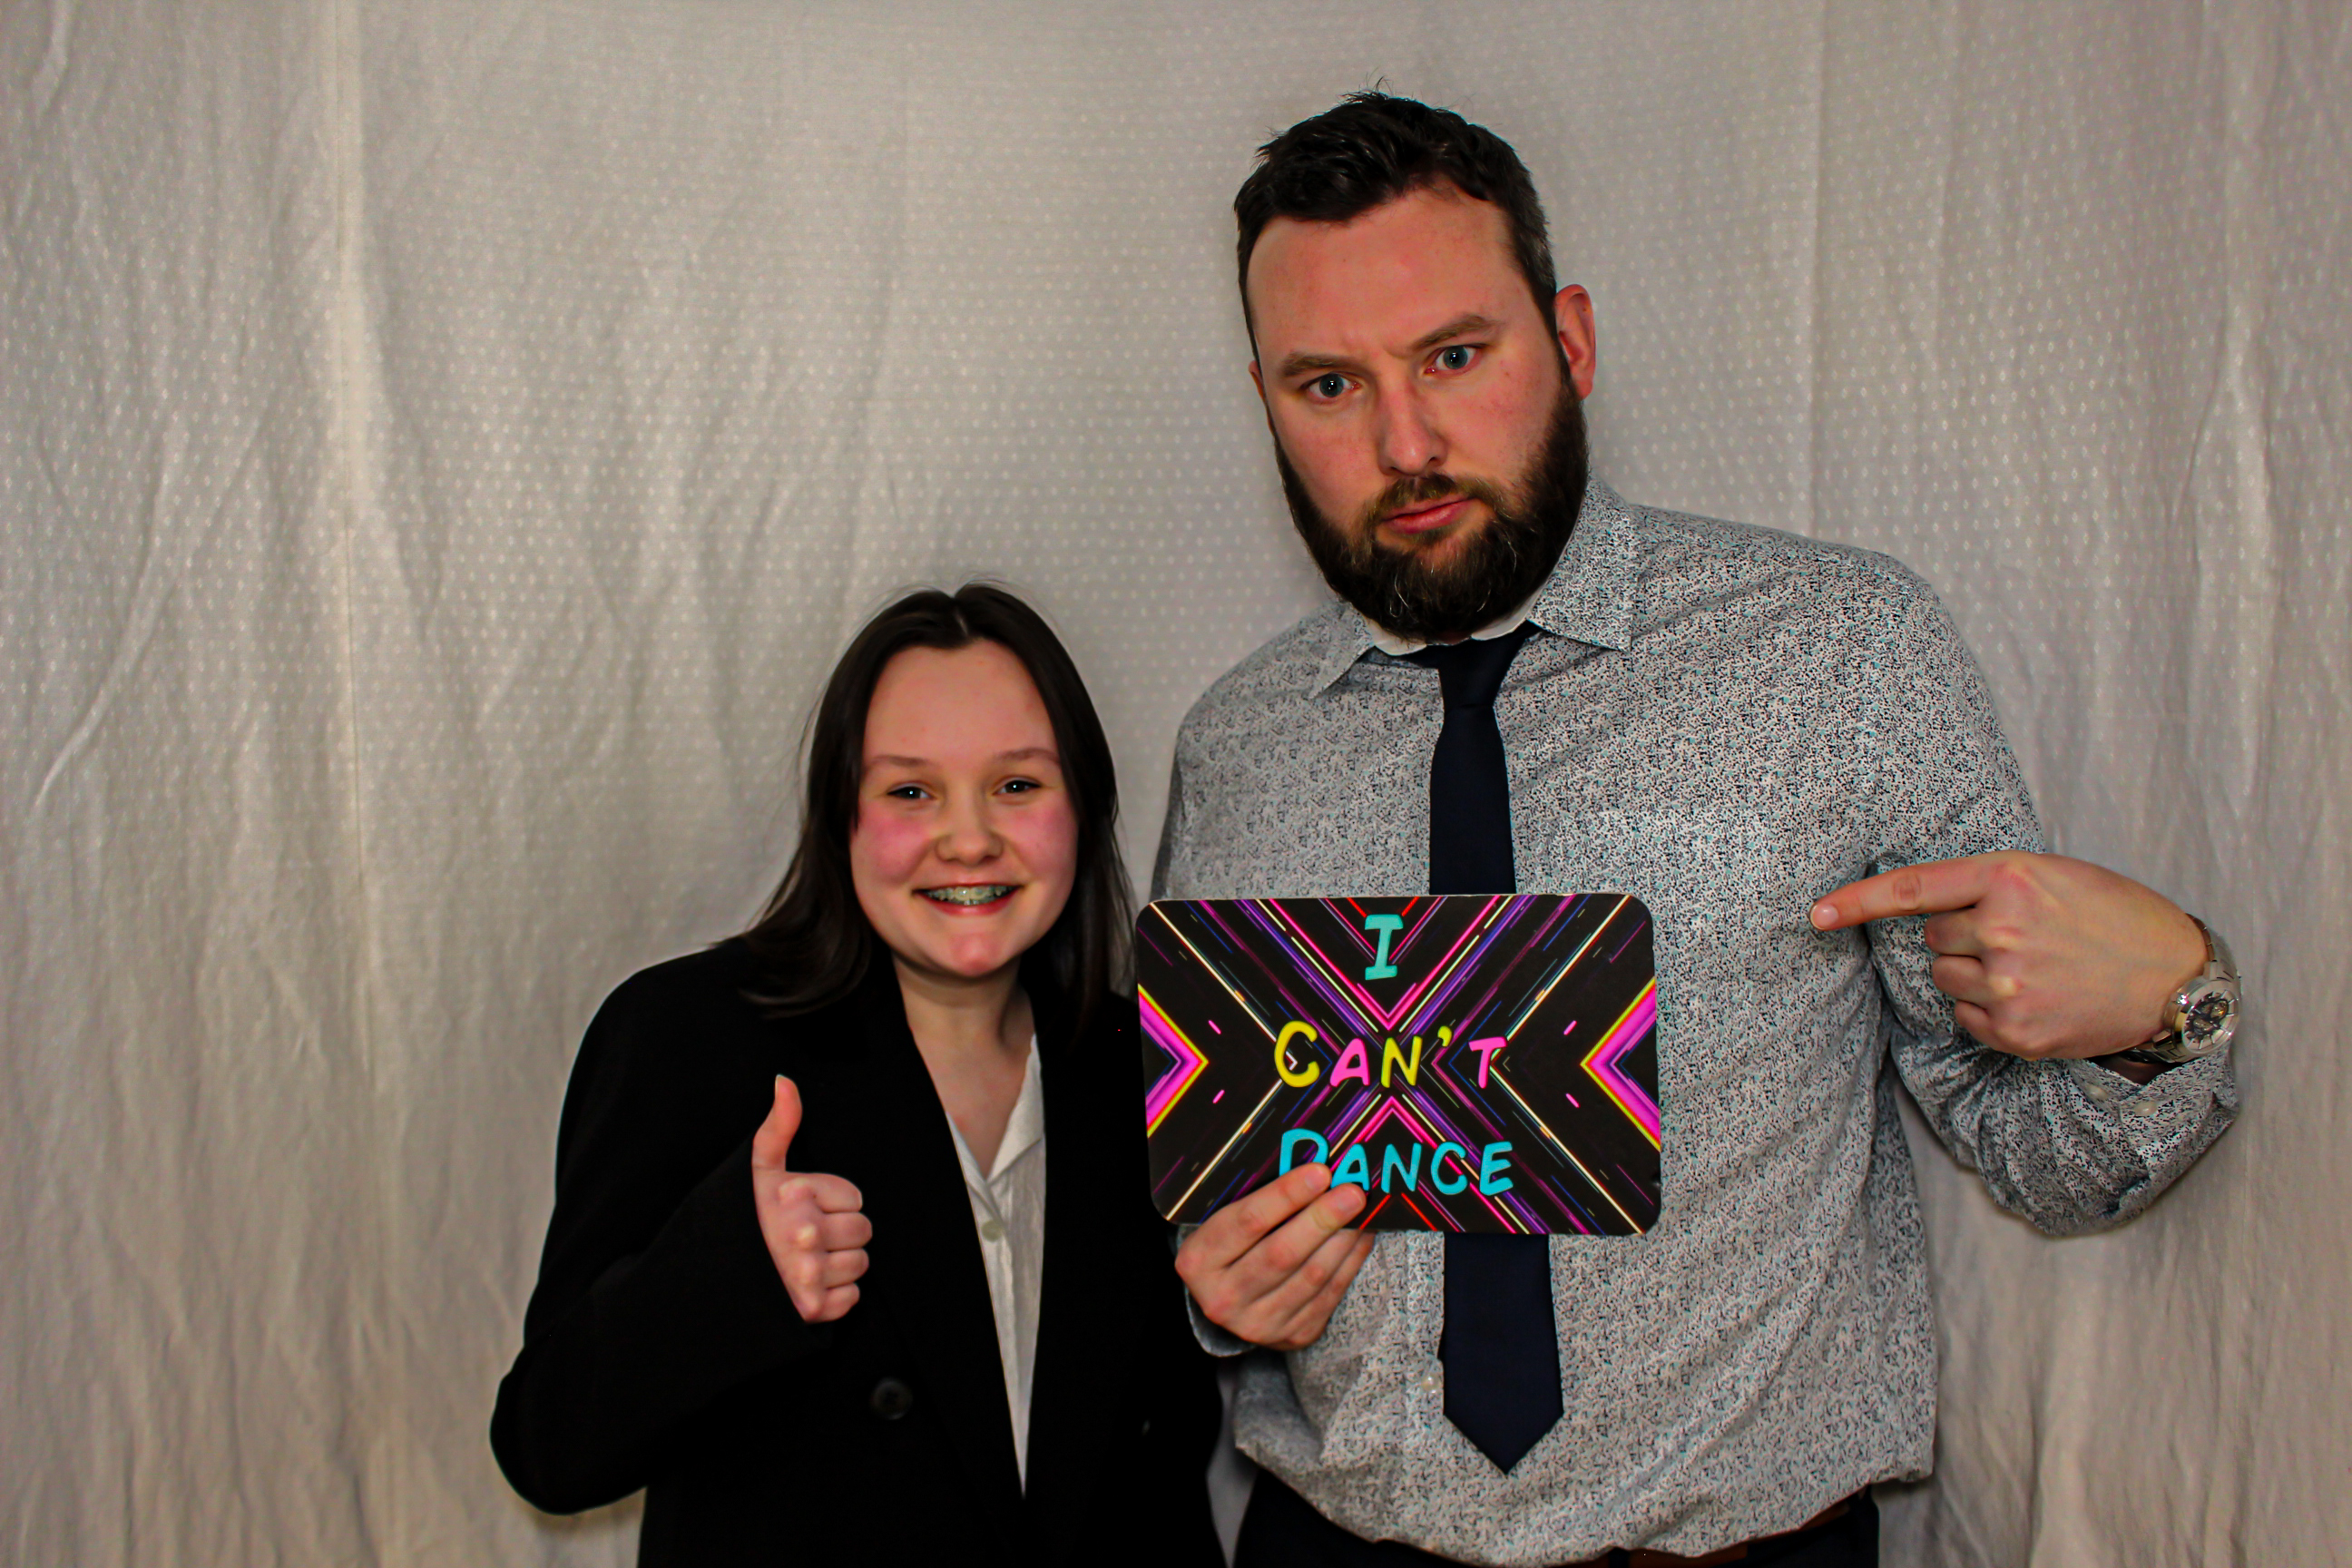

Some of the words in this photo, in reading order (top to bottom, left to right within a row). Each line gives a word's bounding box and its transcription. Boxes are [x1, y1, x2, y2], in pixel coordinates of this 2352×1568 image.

[1365, 914, 1404, 980] I
[1274, 1021, 1507, 1088] CAN'T
[1279, 1128, 1514, 1196] DANCE
